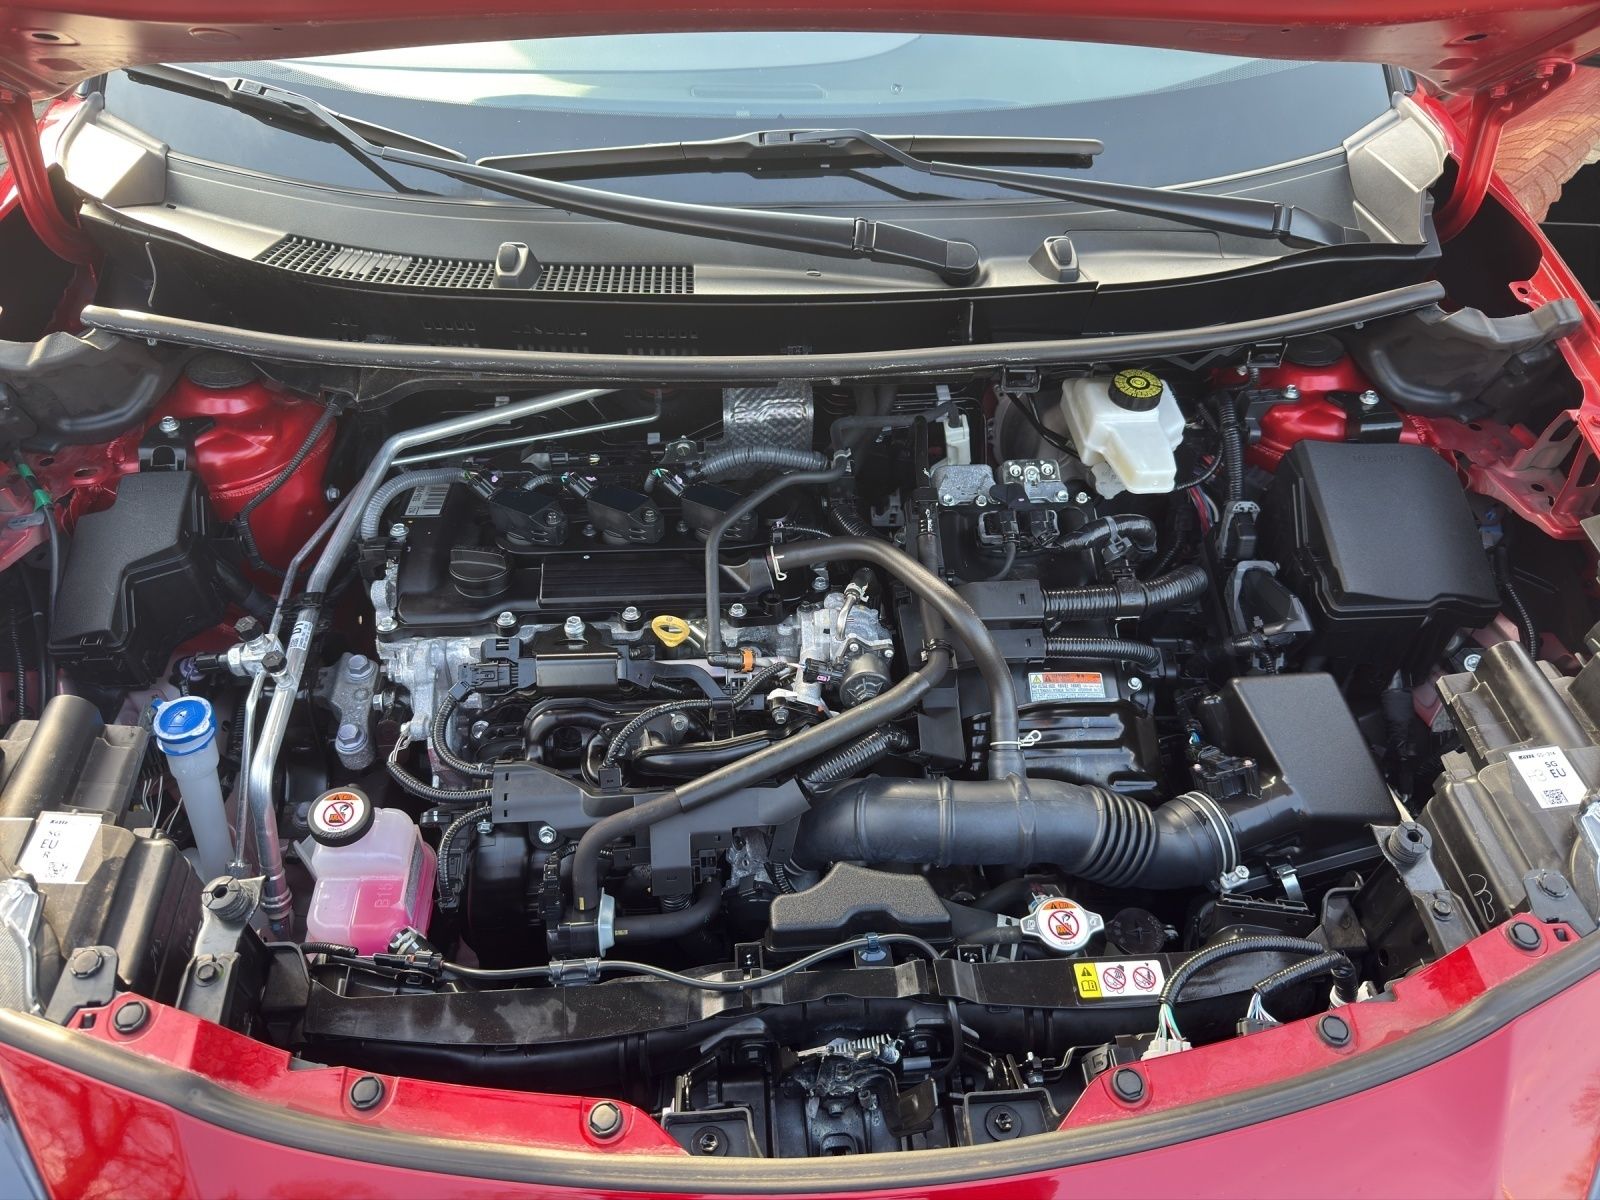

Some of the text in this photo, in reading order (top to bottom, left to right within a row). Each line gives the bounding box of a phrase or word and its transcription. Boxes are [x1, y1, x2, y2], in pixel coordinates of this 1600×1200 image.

[1544, 760, 1558, 768] SG
[1549, 768, 1567, 778] EU
[40, 838, 59, 849] EU
